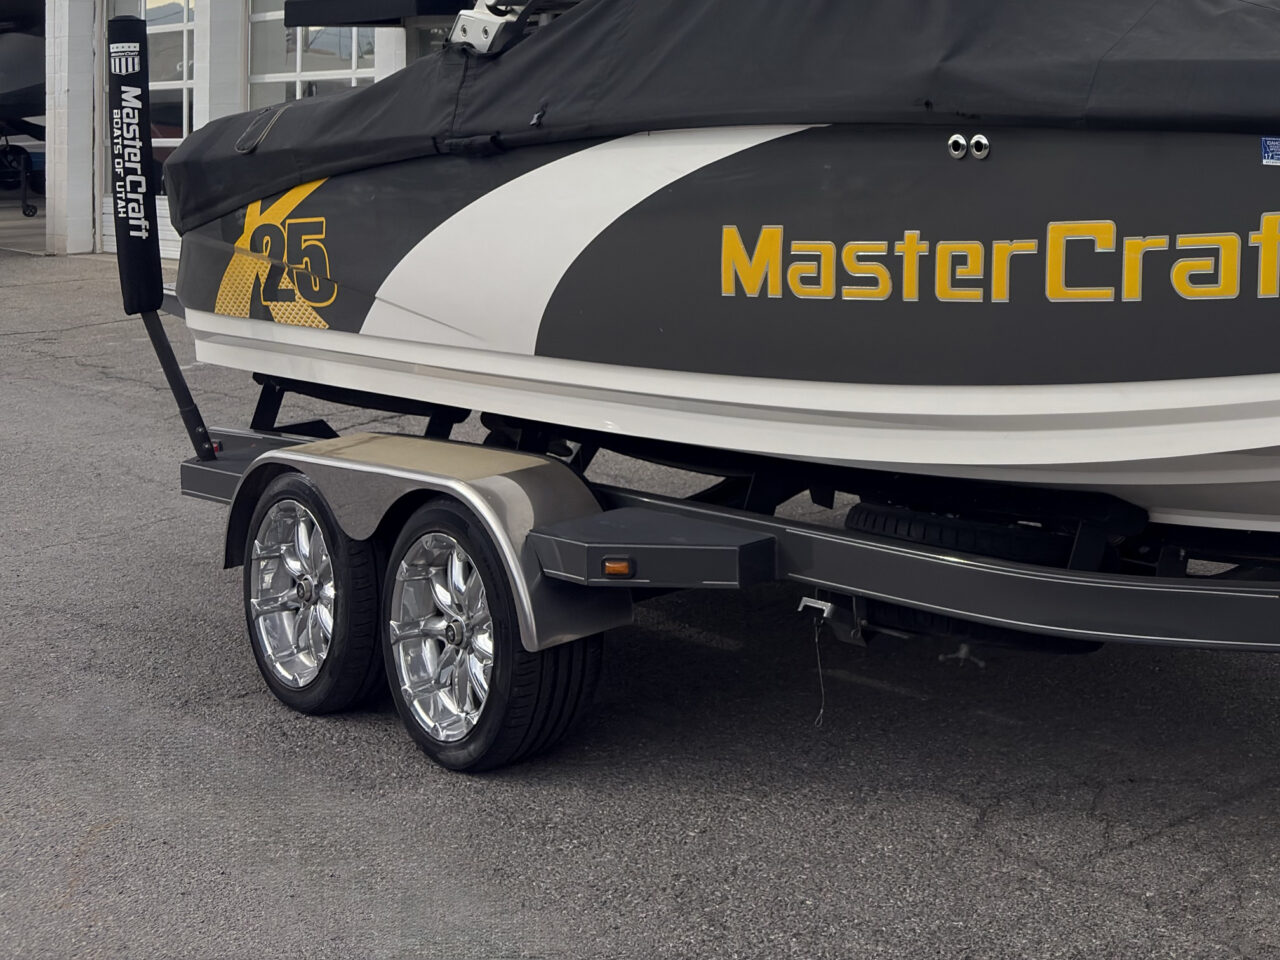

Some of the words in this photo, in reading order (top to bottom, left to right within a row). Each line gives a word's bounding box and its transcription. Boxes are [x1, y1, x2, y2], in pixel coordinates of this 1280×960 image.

[113, 109, 122, 154] BOATS
[115, 158, 123, 177] OF
[121, 85, 149, 239] MasterCraft
[116, 182, 127, 218] UTAH
